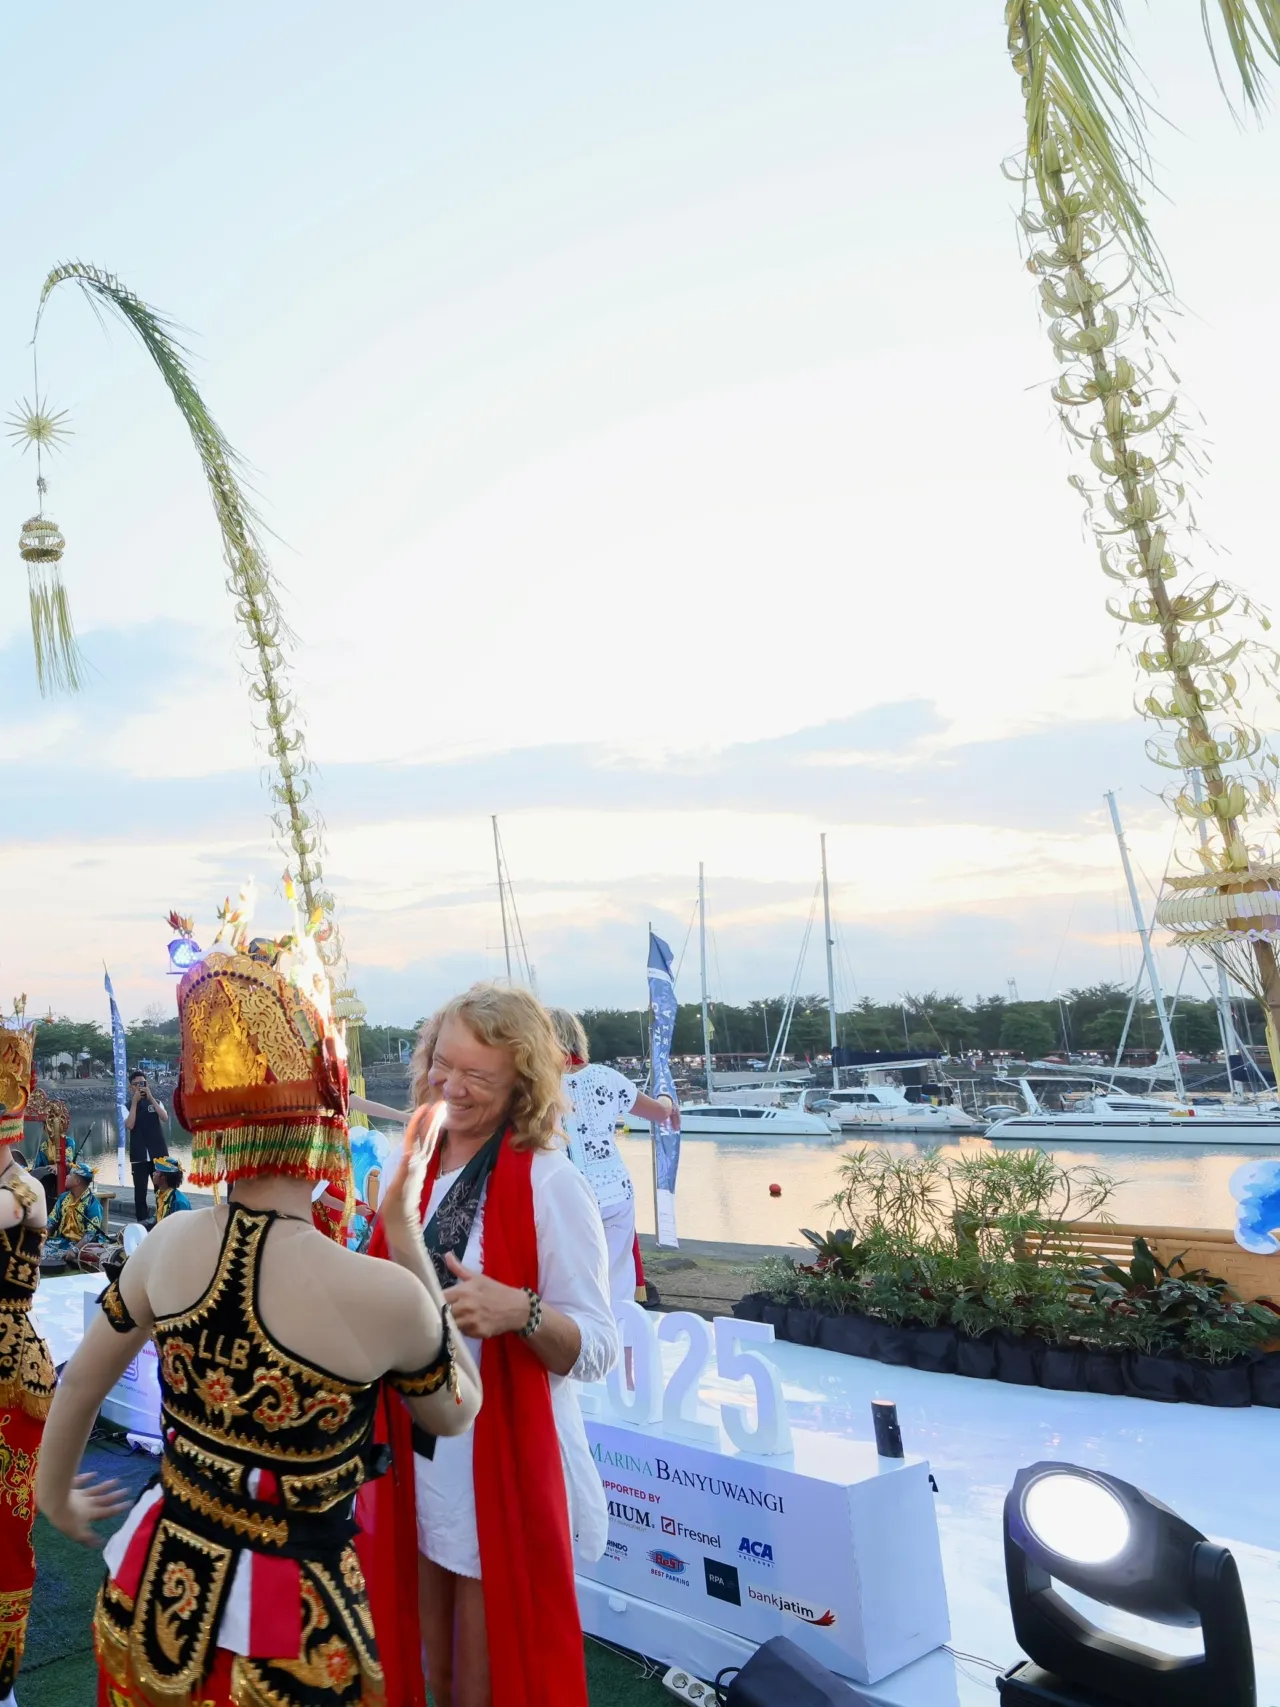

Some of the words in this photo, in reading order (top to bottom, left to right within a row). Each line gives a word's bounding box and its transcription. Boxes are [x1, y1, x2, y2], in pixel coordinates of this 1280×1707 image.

[198, 1329, 250, 1370] LLB
[605, 1300, 794, 1457] 025
[589, 1443, 653, 1476] MARINA
[655, 1458, 785, 1514] BANYUWANGI
[602, 1480, 646, 1500] PPORTED
[648, 1494, 661, 1504] BY
[607, 1500, 651, 1527] MIUM
[606, 1539, 628, 1552] RINDO
[677, 1523, 721, 1548] Fresnel
[738, 1537, 773, 1561] ACA
[650, 1568, 665, 1579] BEST
[665, 1573, 690, 1587] PARKING
[708, 1573, 725, 1586] RPA
